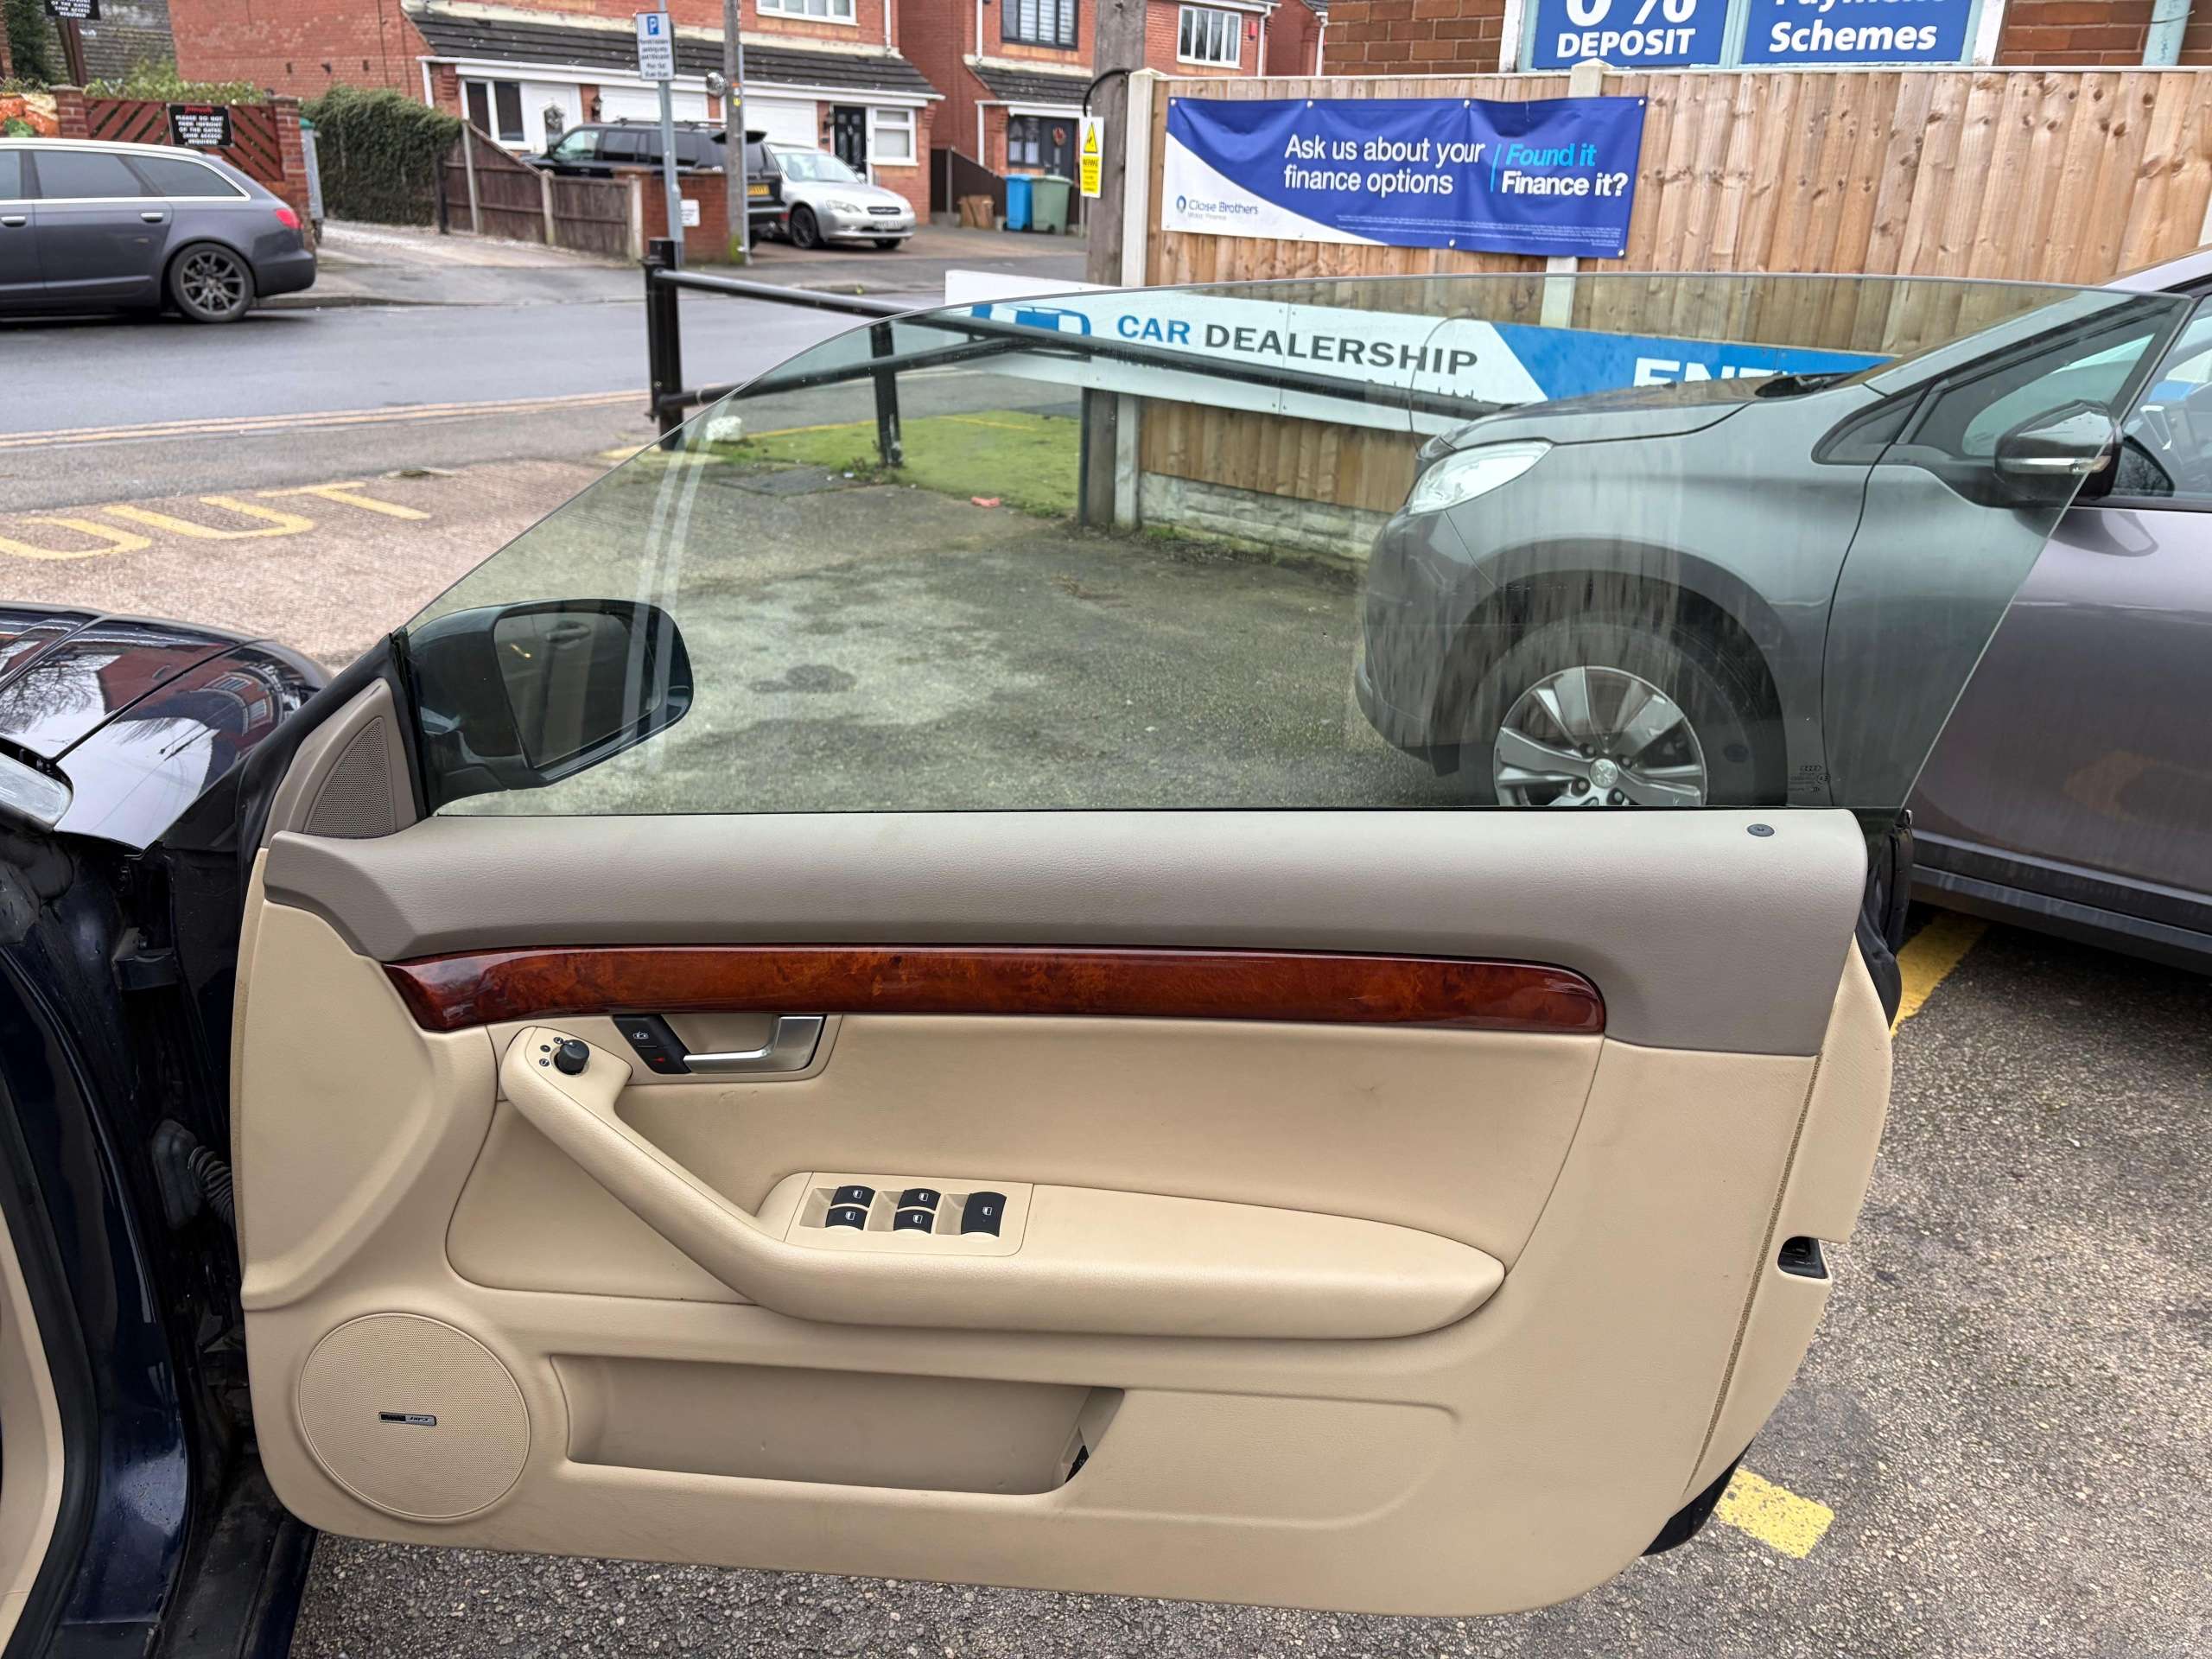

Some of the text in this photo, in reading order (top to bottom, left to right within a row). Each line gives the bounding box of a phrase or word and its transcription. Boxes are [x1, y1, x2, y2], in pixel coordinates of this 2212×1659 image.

[1556, 28, 1696, 59] DEPOSIT
[1769, 18, 1938, 53] Schemes
[1284, 134, 1485, 168] Ask us about your
[1505, 142, 1597, 167] Found it
[1284, 164, 1454, 199] finance options
[1501, 170, 1629, 197] Finance it?
[1188, 199, 1259, 215] Close Brothers
[1116, 315, 1191, 345] CAR
[1205, 323, 1478, 376] DEALERSHIP
